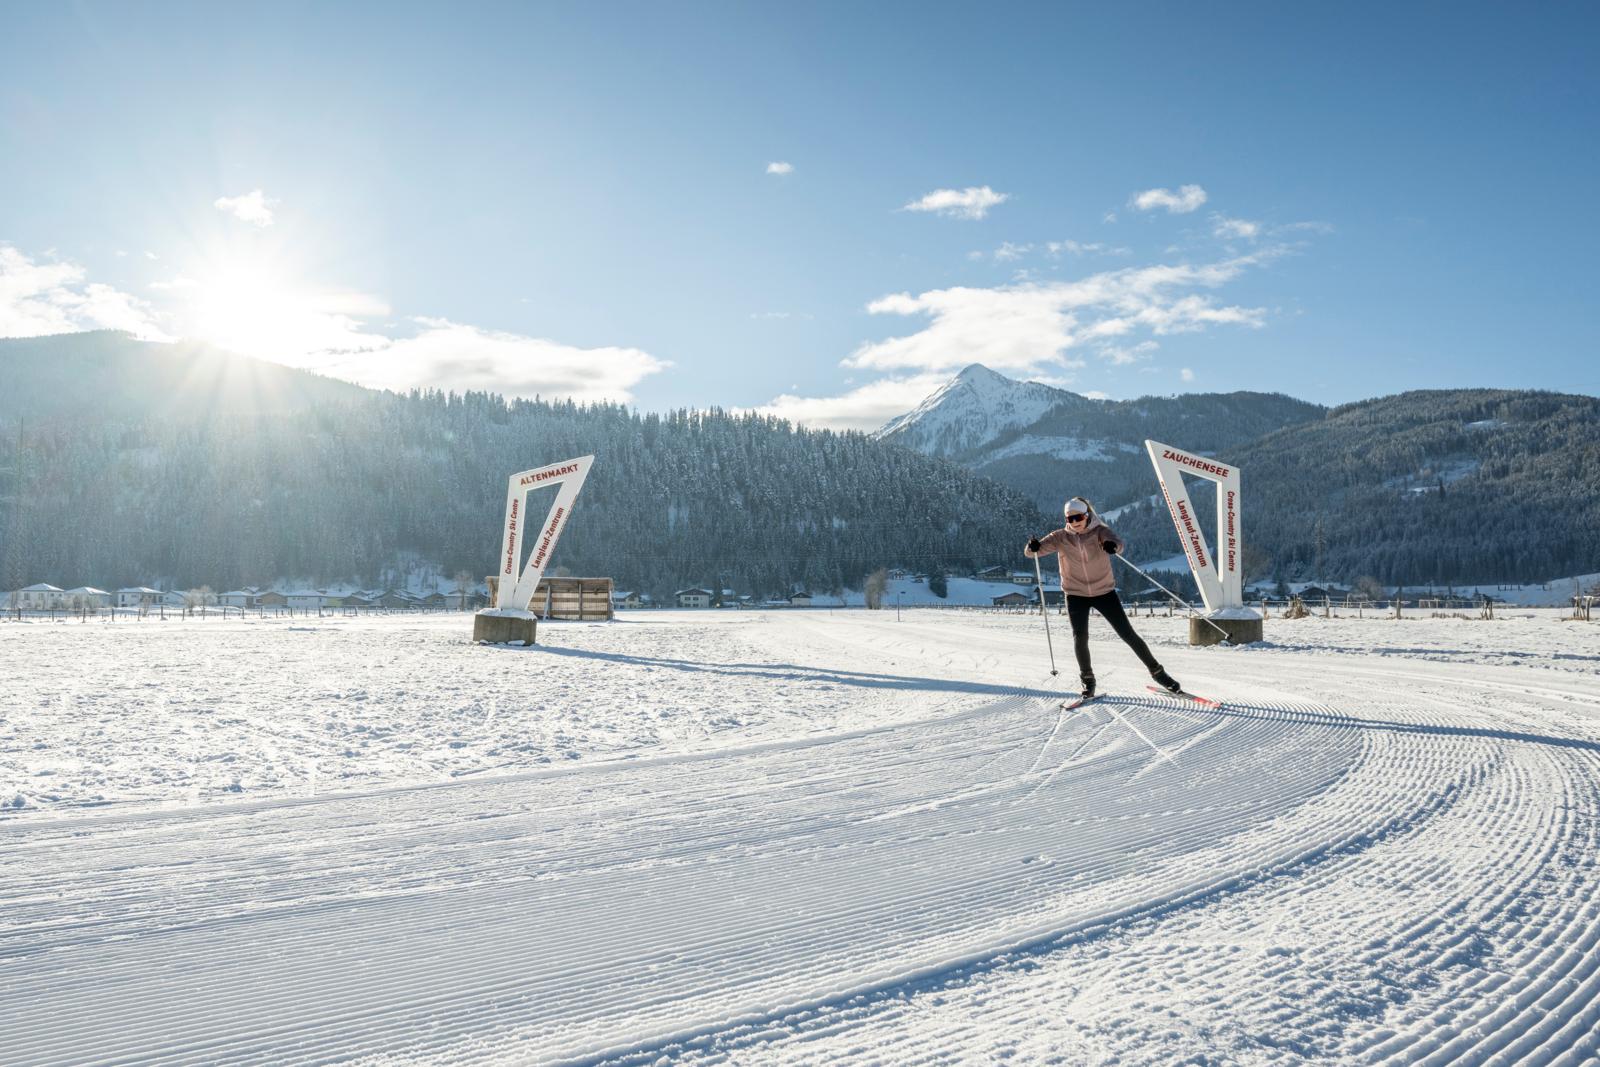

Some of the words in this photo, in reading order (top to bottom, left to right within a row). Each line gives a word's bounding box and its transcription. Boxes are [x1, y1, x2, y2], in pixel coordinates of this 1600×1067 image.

[520, 463, 578, 486] ALTENMARKT
[1162, 450, 1230, 478] ZAUCHENSEE
[510, 498, 518, 519] Centre
[1227, 491, 1235, 537] Cross-Country
[505, 531, 516, 575] Cross-Country
[532, 507, 564, 569] Langlauf-Zentrum
[1177, 500, 1207, 567] Langlauf-Zentrum
